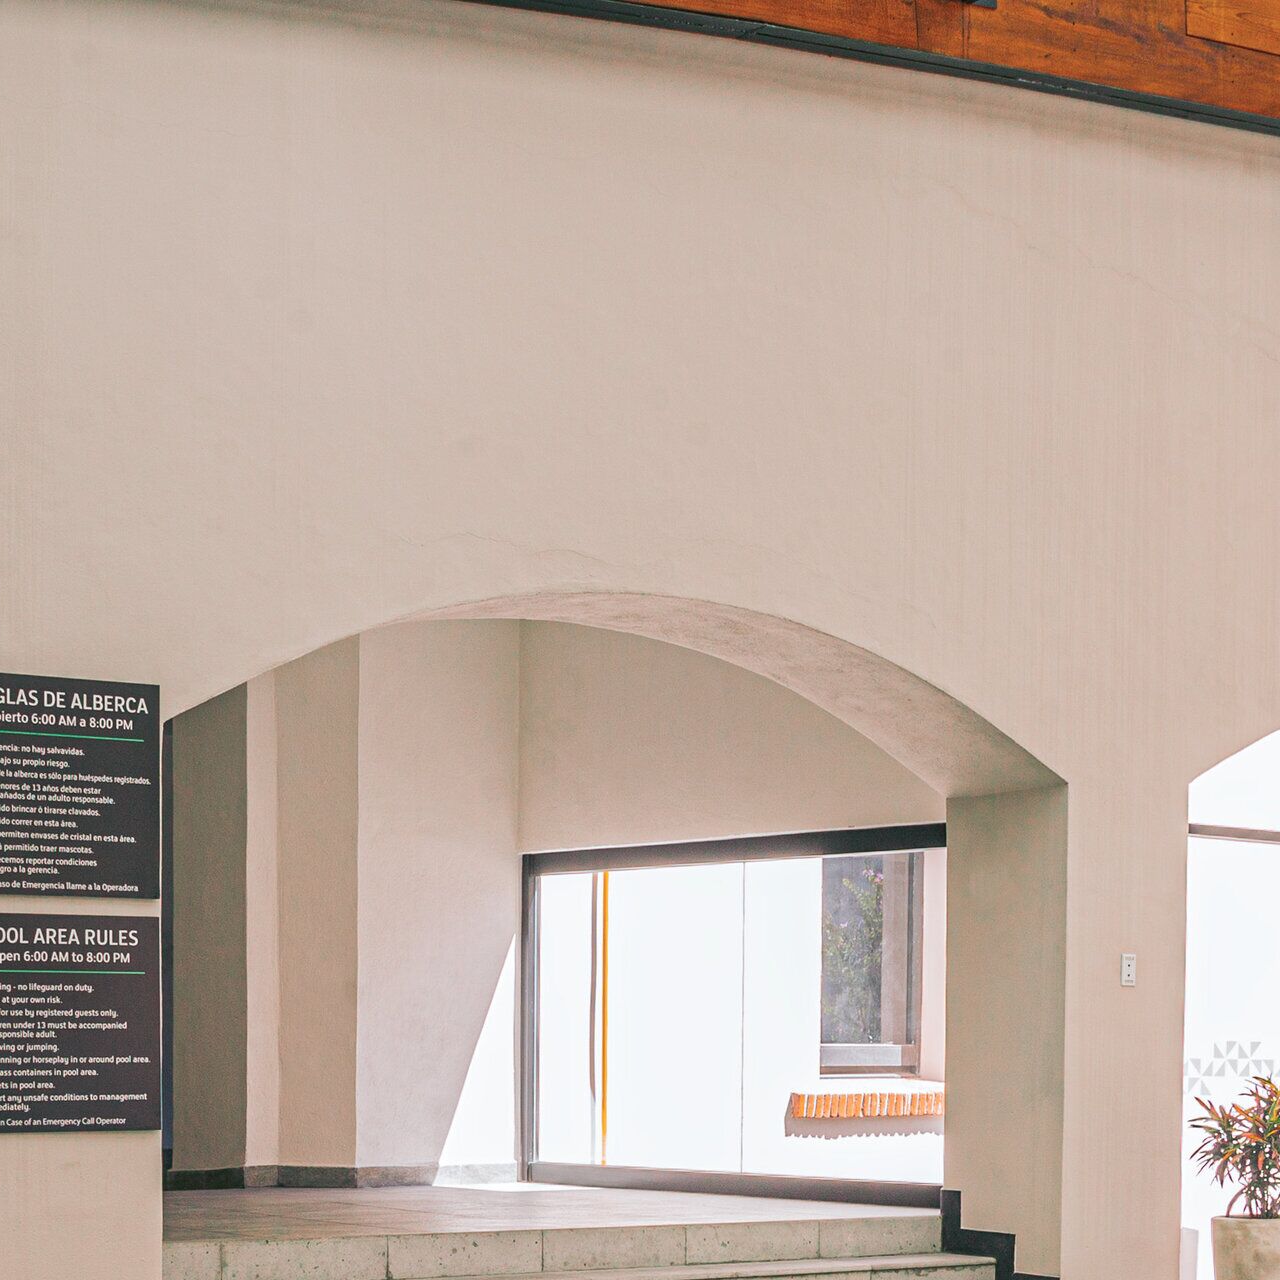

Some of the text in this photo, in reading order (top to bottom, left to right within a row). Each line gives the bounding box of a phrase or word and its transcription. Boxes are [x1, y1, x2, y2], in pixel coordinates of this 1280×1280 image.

[43, 690, 66, 708] DE
[70, 692, 148, 714] ALBERCA
[31, 713, 56, 725] 6:00
[58, 714, 76, 726] AM
[79, 718, 86, 727] a
[89, 716, 113, 729] 8:00
[115, 718, 133, 730] PM
[21, 745, 31, 753] no
[31, 744, 45, 755] hay
[46, 746, 85, 756] salvavidas.
[22, 758, 45, 767] propio
[46, 758, 70, 769] riesgo.
[21, 783, 31, 791] de
[32, 783, 41, 792] 13
[42, 784, 59, 792] años
[60, 785, 82, 793] deben
[26, 792, 36, 800] de
[47, 793, 71, 802] adulto
[71, 796, 115, 804] responsable.
[11, 804, 37, 813] brincar
[37, 805, 43, 813] ó
[43, 806, 67, 815] tirarse
[67, 807, 101, 816] clavados.
[11, 818, 33, 826] correr
[44, 819, 59, 827] esta
[60, 819, 78, 828] área.
[30, 832, 59, 840] envases
[59, 832, 69, 840] de
[69, 832, 92, 841] cristal
[103, 834, 118, 842] esta
[119, 834, 136, 843] área.
[3, 843, 39, 852] permitido
[40, 844, 57, 852] traer
[58, 846, 94, 854] mascotas.
[25, 857, 54, 866] reportar
[55, 857, 97, 866] condiciones
[18, 865, 26, 873] la
[26, 866, 60, 875] gerencia.
[11, 880, 21, 888] de
[22, 880, 65, 891] Emergencia
[65, 881, 87, 890] llame
[93, 882, 101, 891] la
[101, 883, 139, 892] Operadora
[33, 927, 80, 945] AREA
[84, 928, 138, 946] RULES
[23, 950, 48, 962] 6:00
[50, 951, 69, 962] AM
[71, 951, 84, 962] to
[86, 951, 110, 963] 8:00
[112, 952, 130, 963] PM
[28, 982, 62, 993] lifeguard
[74, 983, 94, 993] duty.
[11, 997, 29, 1005] your
[46, 995, 63, 1003] risk.
[24, 1008, 34, 1018] by
[35, 1008, 73, 1018] registered
[74, 1009, 99, 1018] guests
[99, 1008, 118, 1018] only.
[12, 1021, 35, 1029] under
[37, 1021, 46, 1029] 13
[47, 1021, 66, 1029] must
[67, 1021, 77, 1029] be
[78, 1021, 127, 1030] accompanied
[35, 1030, 57, 1038] adult.
[25, 1042, 59, 1053] jumping.
[32, 1055, 69, 1065] horseplay
[70, 1055, 78, 1063] in
[88, 1055, 114, 1063] around
[115, 1055, 131, 1065] pool
[12, 1068, 52, 1076] containers
[53, 1068, 61, 1076] in
[62, 1068, 79, 1078] pool
[10, 1081, 18, 1089] in
[19, 1080, 35, 1091] pool
[7, 1095, 22, 1104] any
[23, 1093, 48, 1101] unsafe
[49, 1093, 89, 1101] conditions
[89, 1093, 98, 1101] to
[99, 1093, 147, 1102] management
[6, 1118, 23, 1126] Case
[23, 1117, 31, 1126] of
[42, 1117, 81, 1127] Emergency
[81, 1117, 95, 1125] Call
[95, 1116, 126, 1126] Operator
